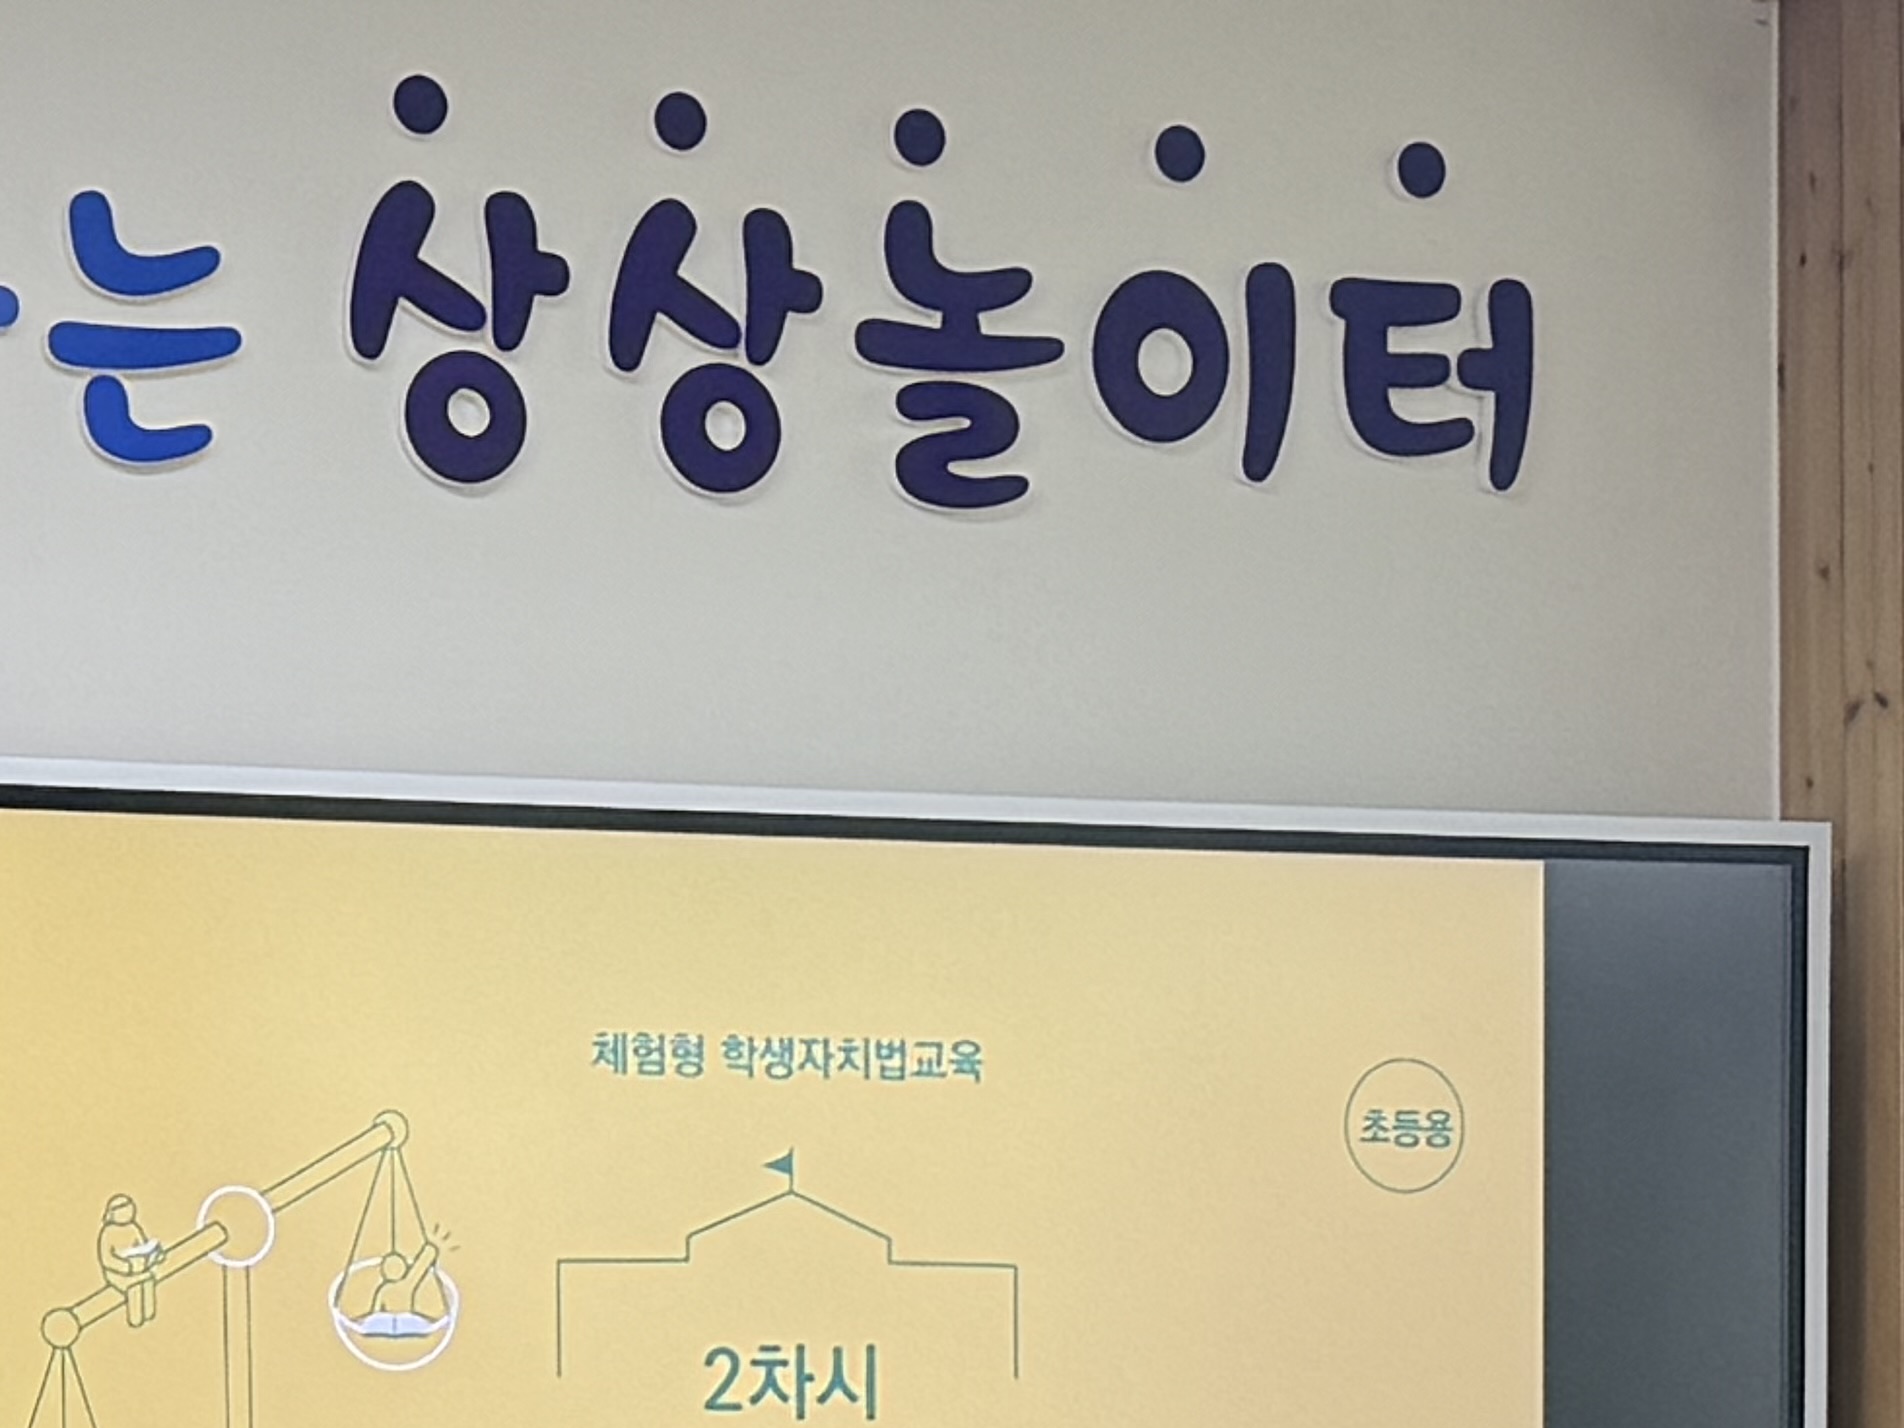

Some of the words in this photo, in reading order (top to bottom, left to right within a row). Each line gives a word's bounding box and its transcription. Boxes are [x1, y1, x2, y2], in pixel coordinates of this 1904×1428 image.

[348, 75, 1536, 511] 상상놀이터
[590, 1030, 706, 1080] 체험형
[719, 1032, 984, 1085] 학생자치법교육
[1358, 1107, 1456, 1151] 초등용
[702, 1341, 878, 1423] 2차시
